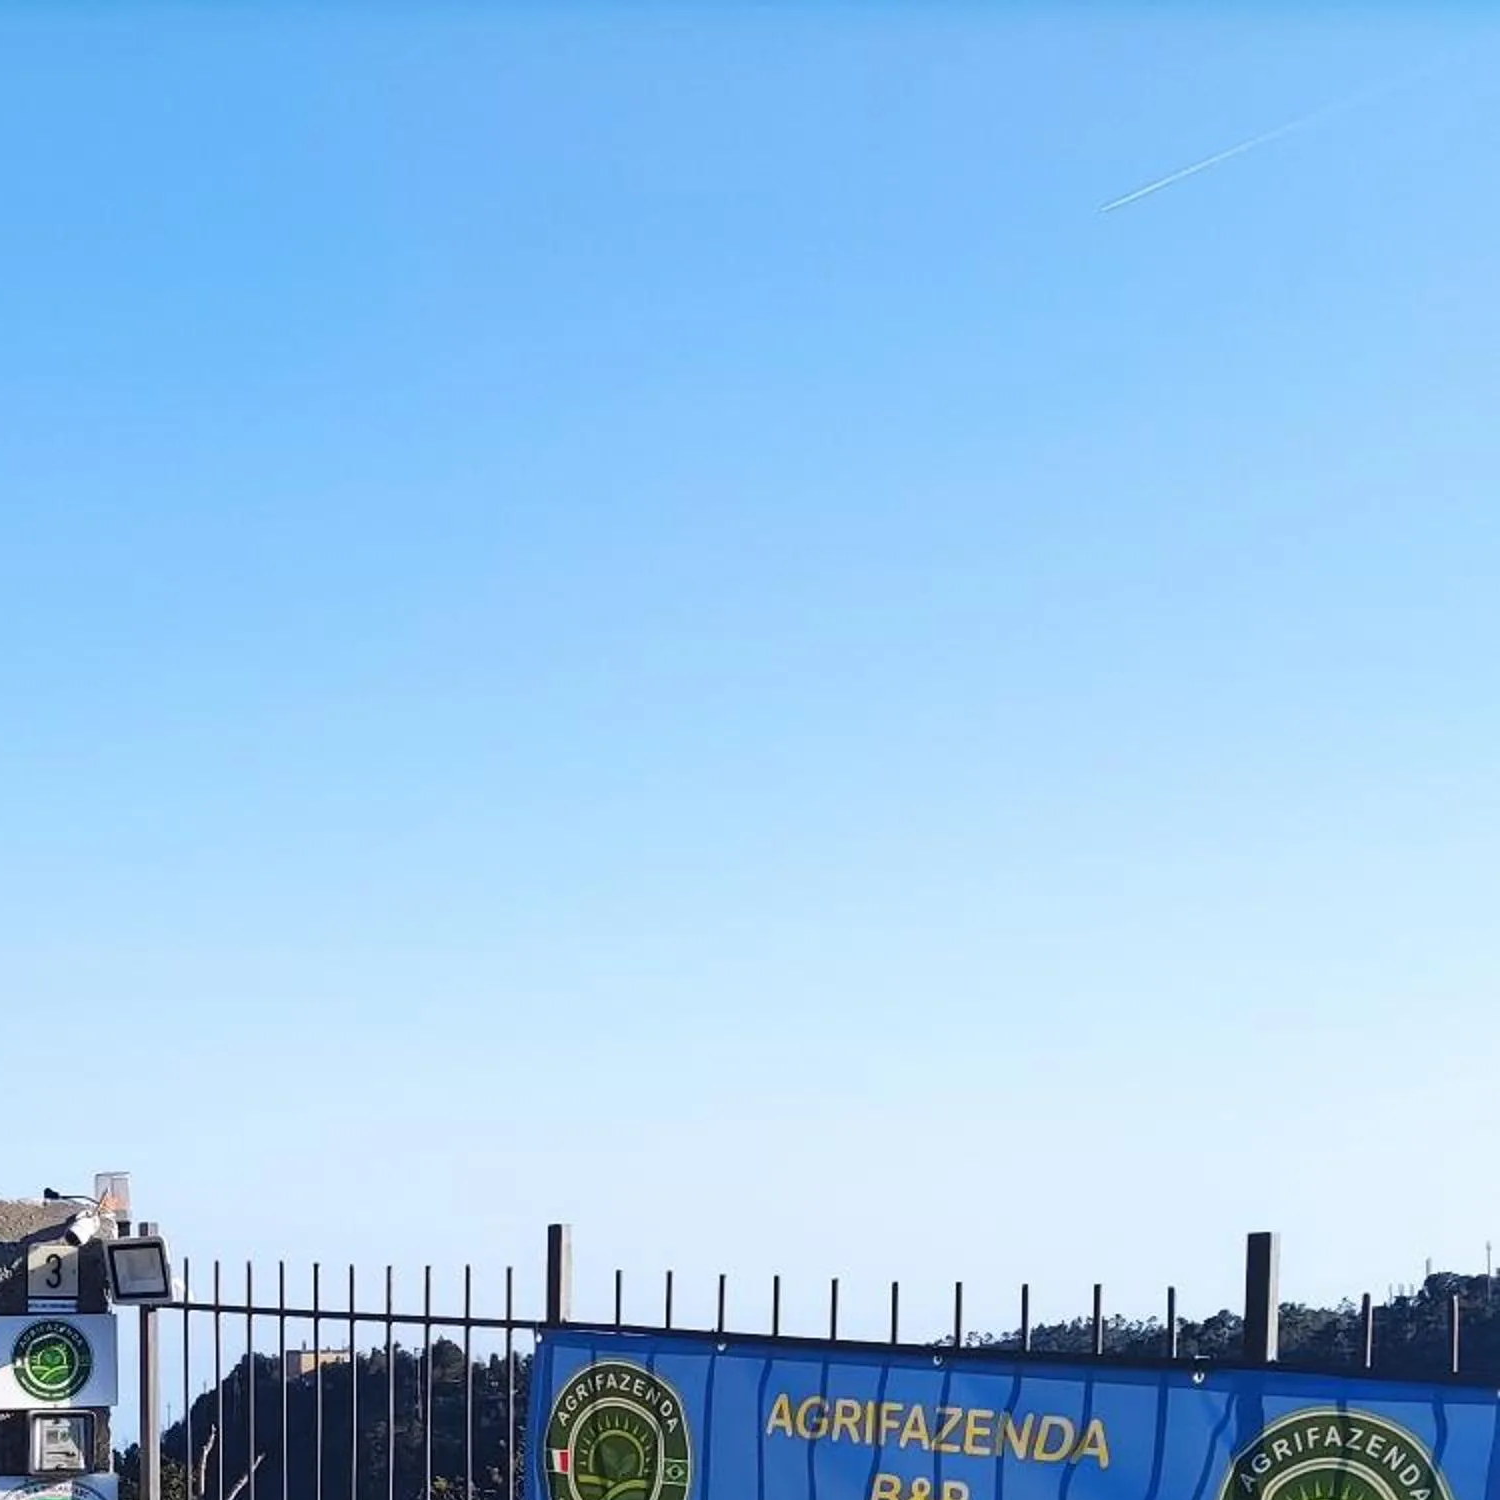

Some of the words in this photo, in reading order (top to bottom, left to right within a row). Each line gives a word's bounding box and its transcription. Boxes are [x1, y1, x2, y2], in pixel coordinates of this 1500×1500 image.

[46, 1253, 62, 1288] 3
[557, 1372, 680, 1434] AGRIFAZENDA
[765, 1392, 1110, 1470] AGRIFAZENDA
